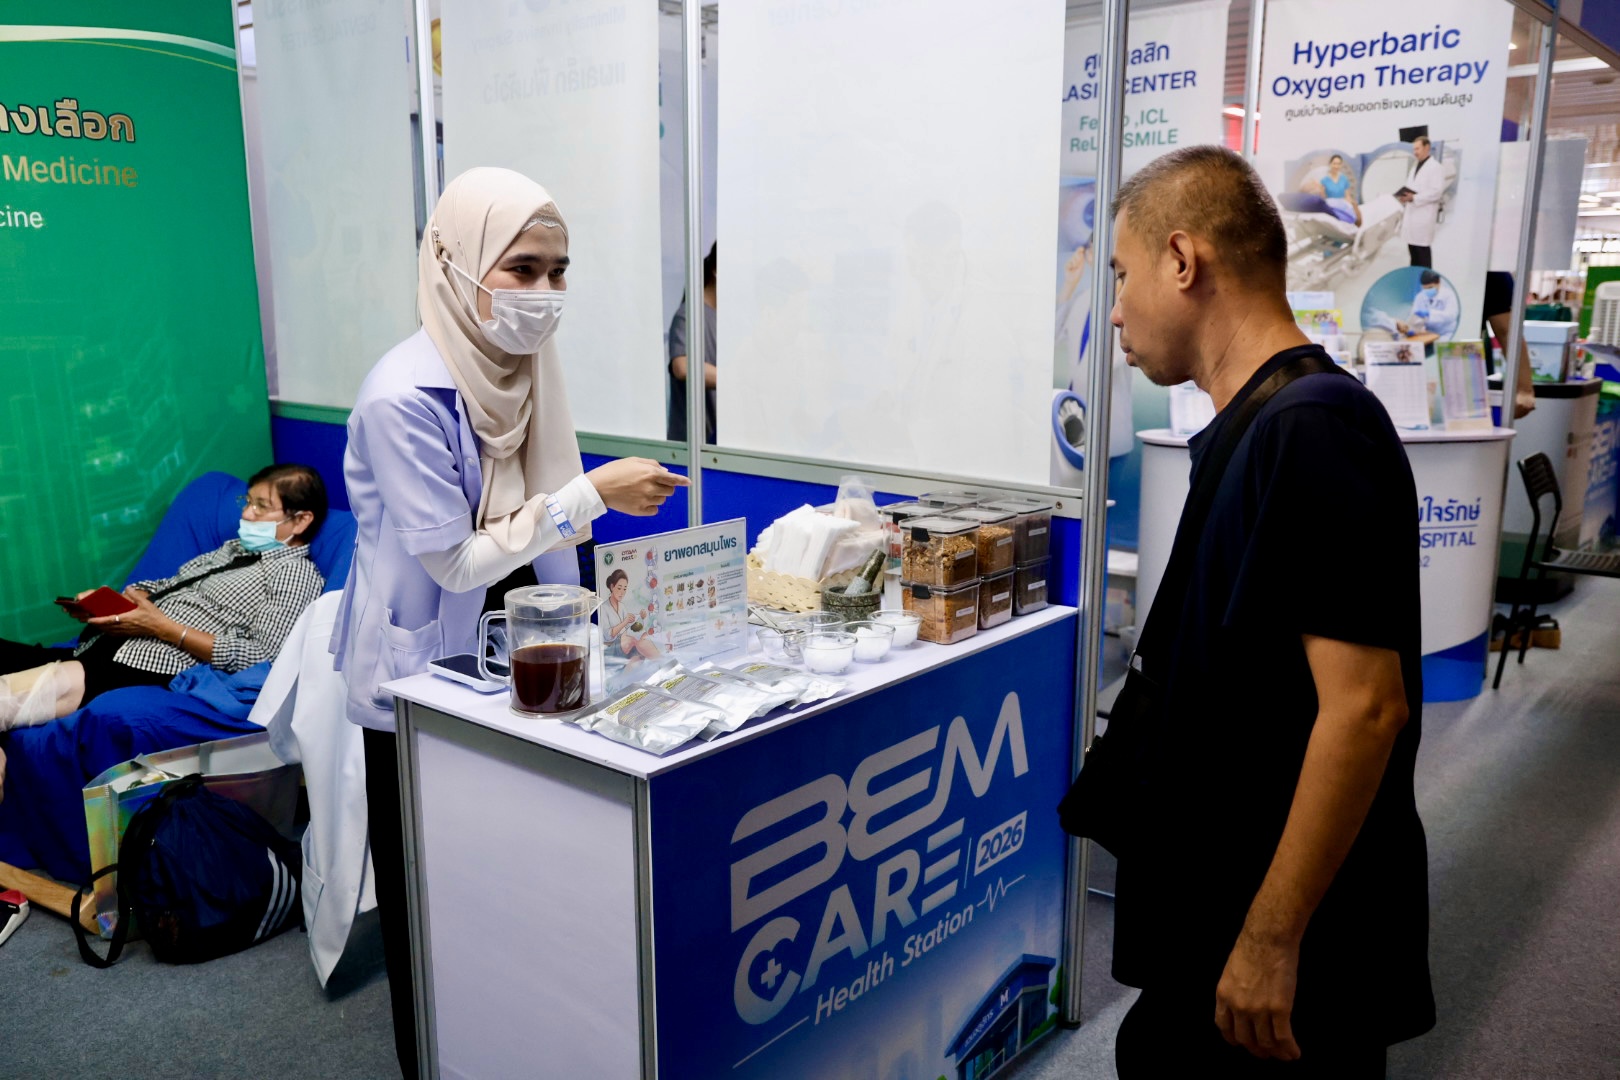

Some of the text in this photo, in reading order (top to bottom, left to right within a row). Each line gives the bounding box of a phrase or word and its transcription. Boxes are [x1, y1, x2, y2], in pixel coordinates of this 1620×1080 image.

[1293, 24, 1461, 69] Hyperbaric
[1272, 59, 1490, 99] Oxygen Therapy
[2, 154, 138, 188] Medicine
[0, 205, 44, 229] cine
[664, 535, 737, 562] ยาพอกสมุนไพร
[1419, 531, 1477, 549] SPITAL
[730, 691, 1029, 933] BEM
[733, 817, 1024, 1025] CARE 2026
[815, 902, 974, 1026] Health Station
